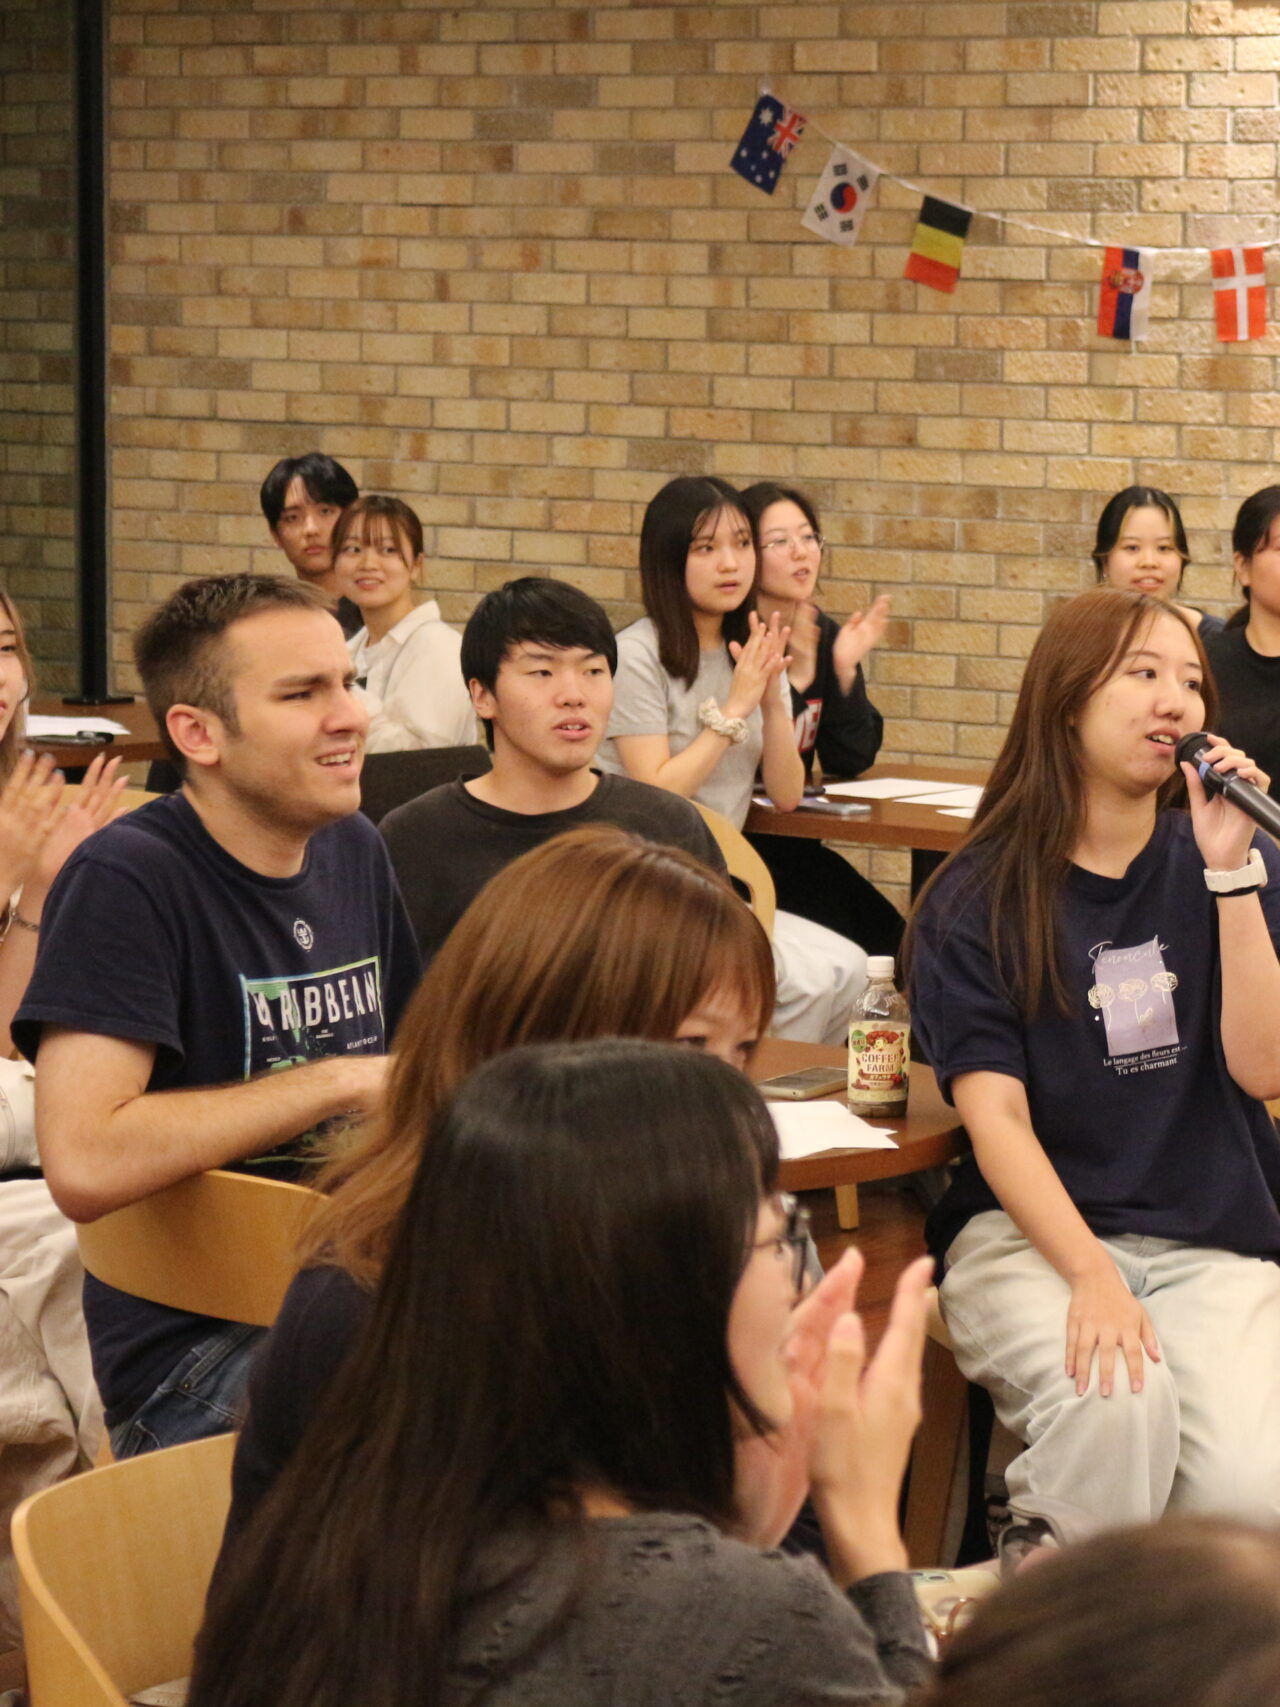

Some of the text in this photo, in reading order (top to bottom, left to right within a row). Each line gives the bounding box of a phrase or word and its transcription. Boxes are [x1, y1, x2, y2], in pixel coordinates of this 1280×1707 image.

[861, 1053, 899, 1063] COFFEE
[1103, 1058, 1112, 1066] Le
[1113, 1056, 1139, 1066] langage
[1152, 1049, 1170, 1058] fleurs
[866, 1063, 894, 1072] FARM
[1115, 1057, 1177, 1076] Tu es charmant
